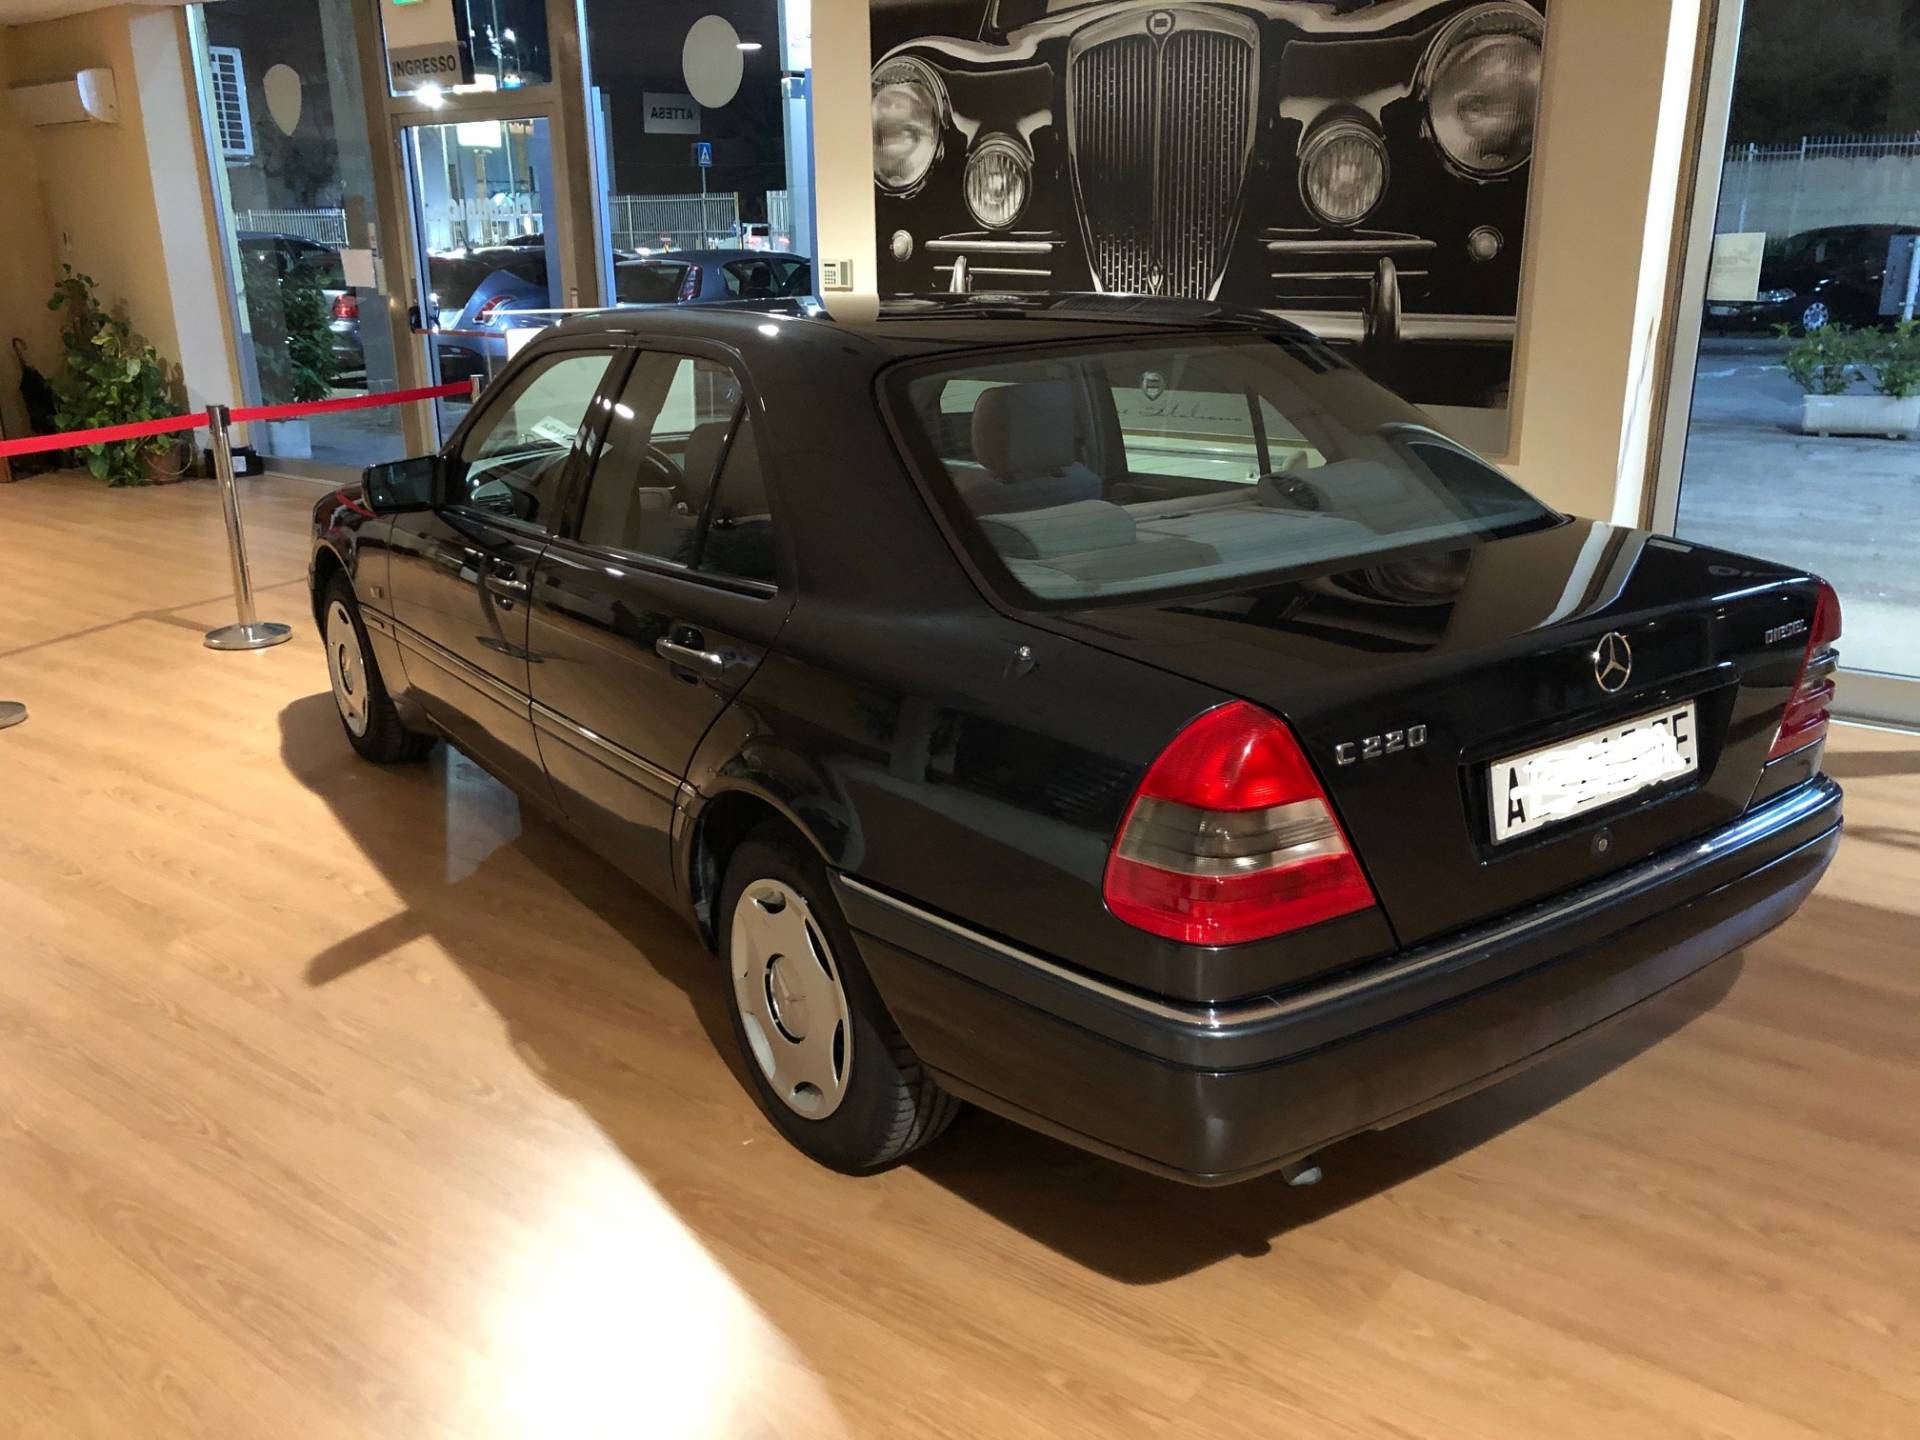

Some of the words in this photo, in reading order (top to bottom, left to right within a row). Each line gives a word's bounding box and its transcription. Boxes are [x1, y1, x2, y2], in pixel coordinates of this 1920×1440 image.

[392, 55, 456, 77] INGRESSO
[1765, 619, 1808, 644] DIESEL
[1336, 742, 1356, 765] C
[1363, 724, 1428, 759] 220
